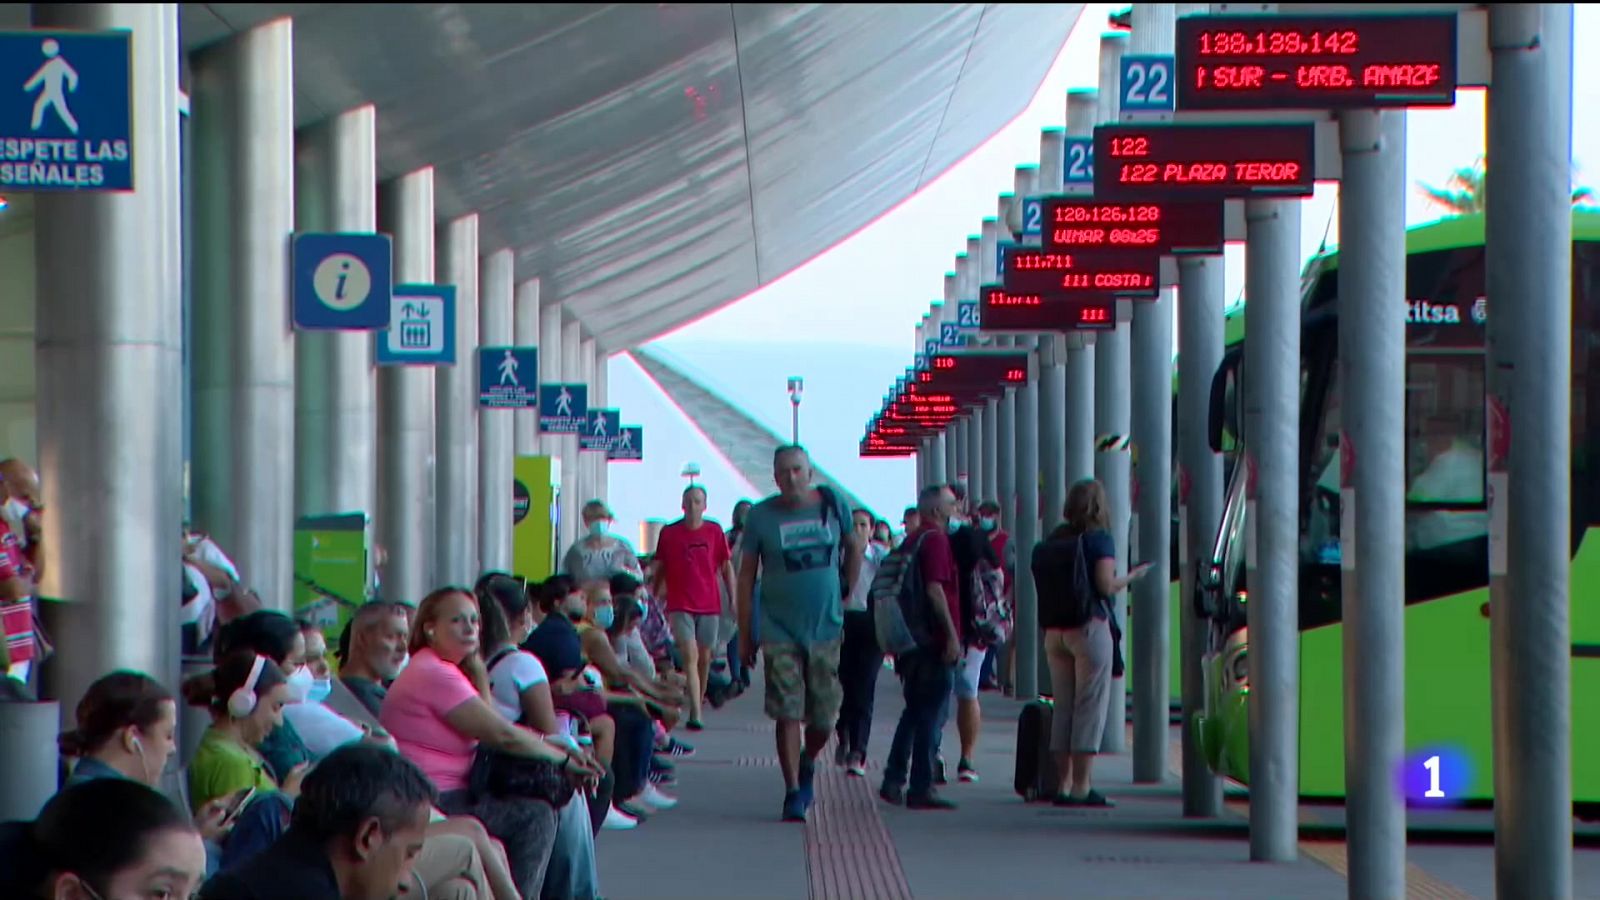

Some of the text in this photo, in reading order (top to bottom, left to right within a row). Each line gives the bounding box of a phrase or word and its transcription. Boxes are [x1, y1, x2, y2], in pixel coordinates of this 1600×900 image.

[1126, 63, 1168, 103] 22
[1213, 65, 1263, 87] SUR
[1297, 65, 1353, 87] URB.
[84, 139, 129, 161] LAS
[1111, 137, 1148, 156] 122
[0, 158, 104, 186] SEÑALES
[1119, 161, 1299, 182] 122 PLAZA TEROR
[1055, 206, 1160, 222] 120,126,128
[1063, 274, 1089, 287] 111
[1094, 273, 1141, 287] COSTA
[943, 324, 961, 346] 27
[935, 357, 955, 368] 110
